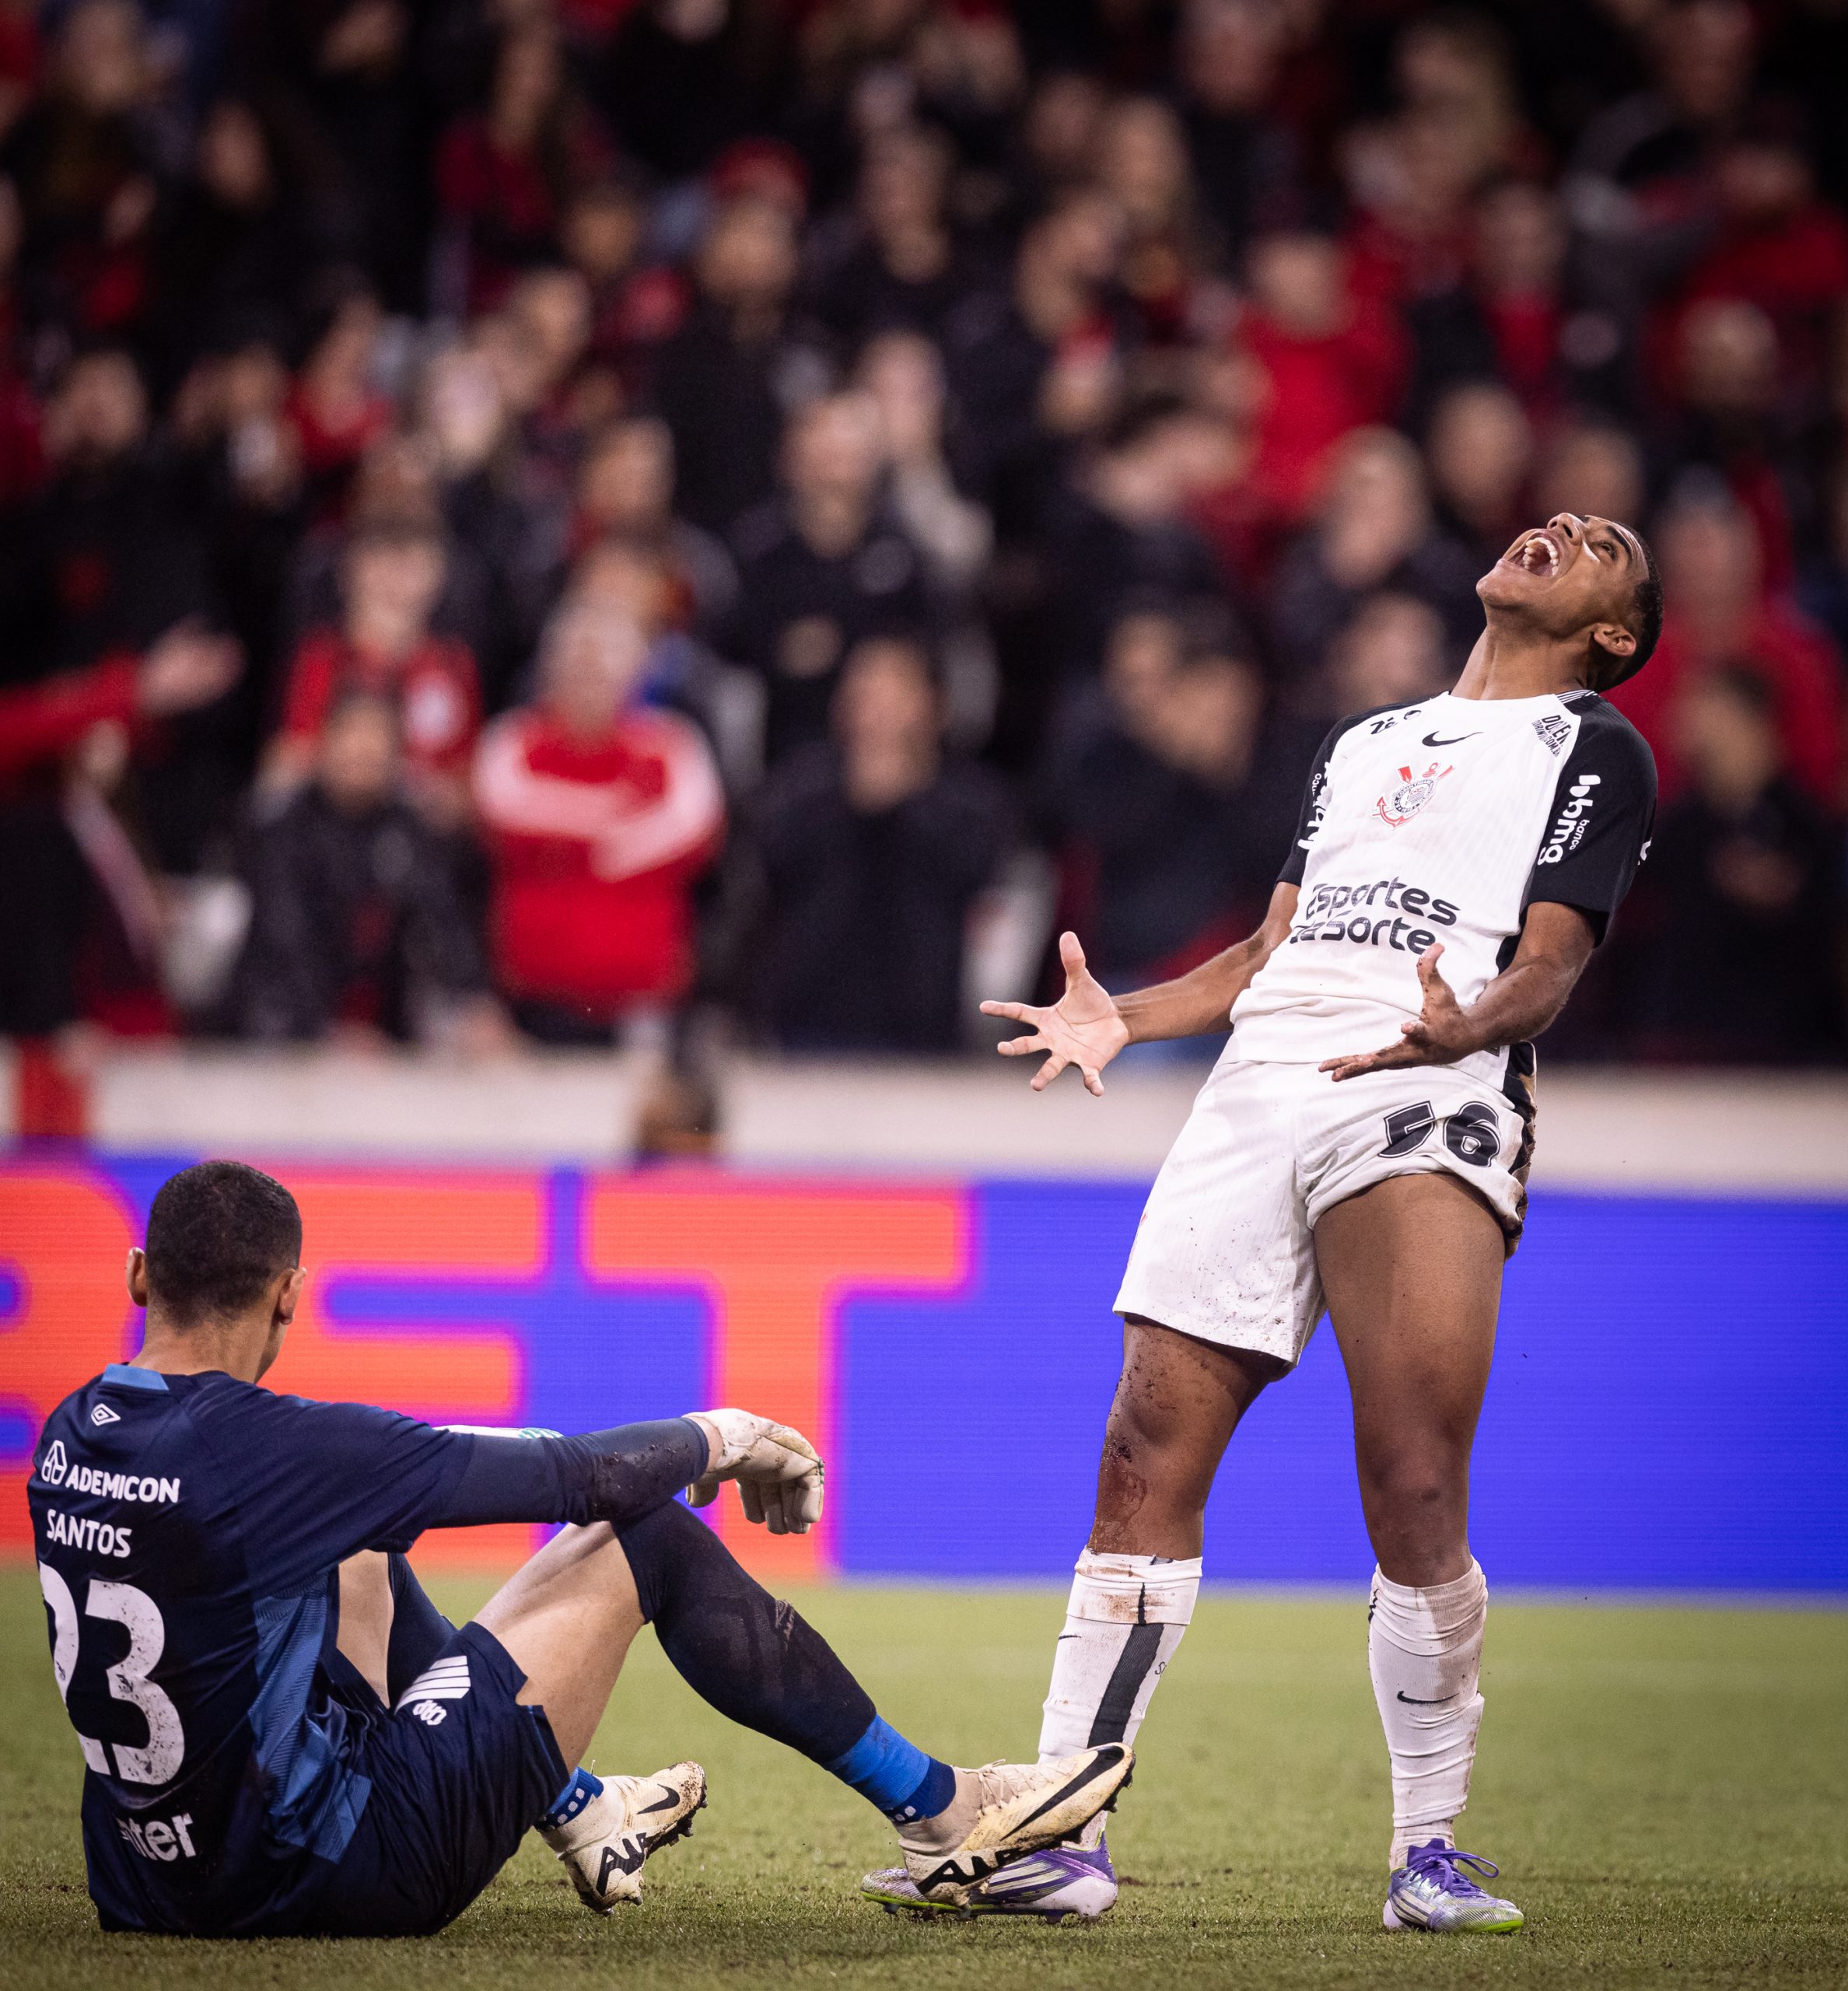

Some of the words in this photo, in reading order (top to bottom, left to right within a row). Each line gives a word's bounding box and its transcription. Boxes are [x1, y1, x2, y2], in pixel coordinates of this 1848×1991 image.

[1537, 798, 1594, 866] bmg
[1569, 819, 1591, 851] banco
[1306, 876, 1461, 926] Esportes
[1321, 909, 1437, 956] Sorte
[1377, 1100, 1500, 1168] 56
[65, 1464, 180, 1503] ADEMICON
[47, 1509, 132, 1558] SANTOS
[39, 1560, 185, 1786] 23
